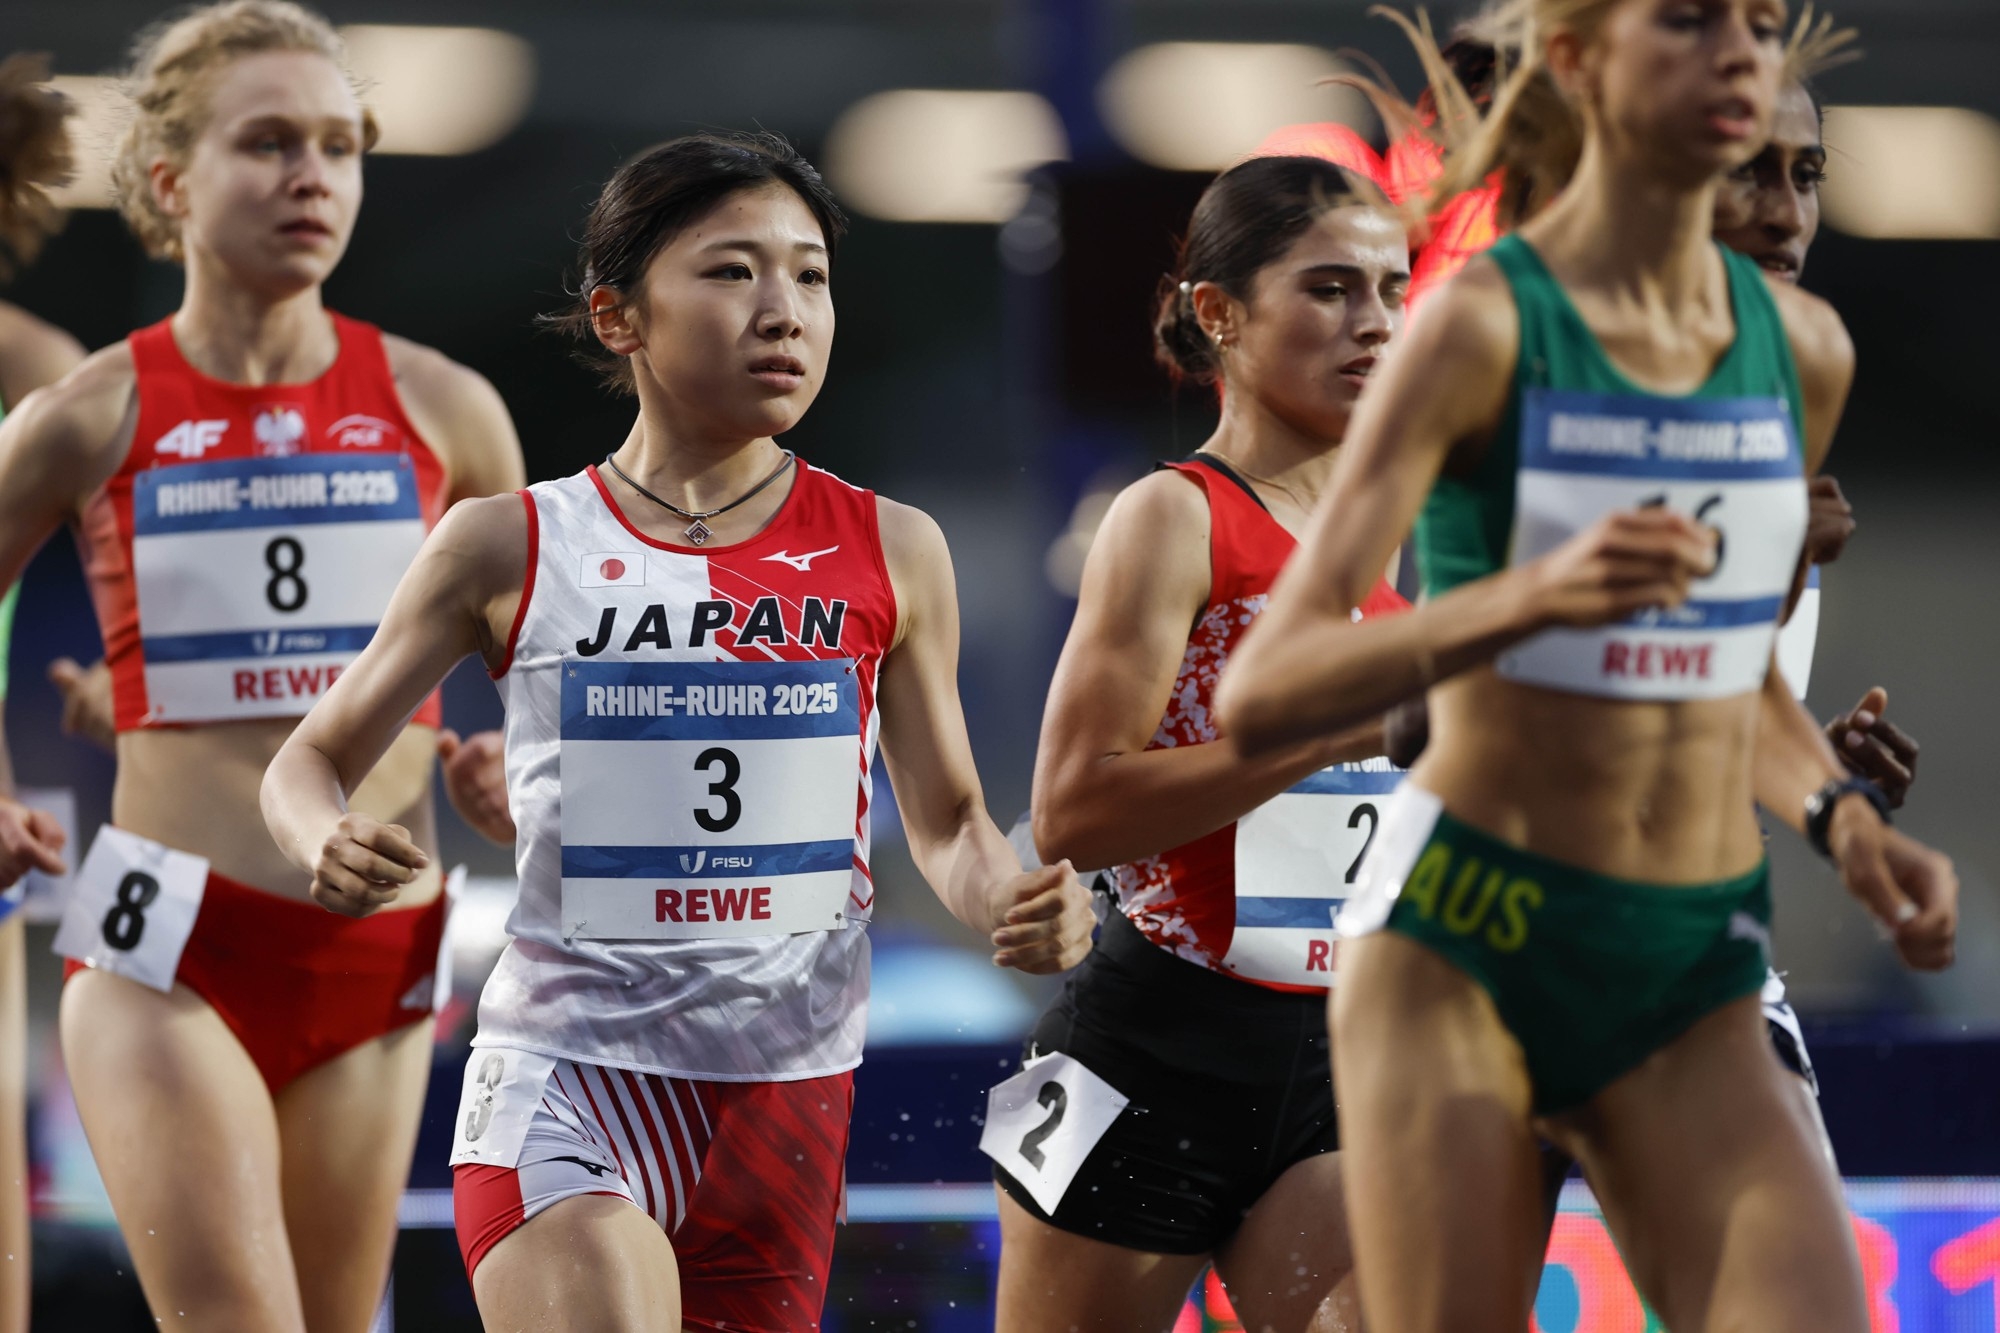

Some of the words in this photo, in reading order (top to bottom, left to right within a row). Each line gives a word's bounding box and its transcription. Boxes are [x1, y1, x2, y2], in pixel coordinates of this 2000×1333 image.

[157, 473, 327, 517] RHINE-RUHR
[330, 471, 398, 506] 2025
[264, 536, 308, 613] 8
[576, 596, 848, 657] JAPAN
[1603, 642, 1715, 679] REWE
[586, 685, 767, 717] RHINE-RUHR
[772, 682, 839, 716] 2025
[693, 747, 742, 833] 3
[712, 856, 753, 869] FISU
[1345, 802, 1379, 884] 2
[103, 870, 160, 951] 8
[655, 886, 772, 923] REWE
[1403, 842, 1545, 953] AUS
[465, 1053, 505, 1142] 3
[1018, 1080, 1068, 1173] 2
